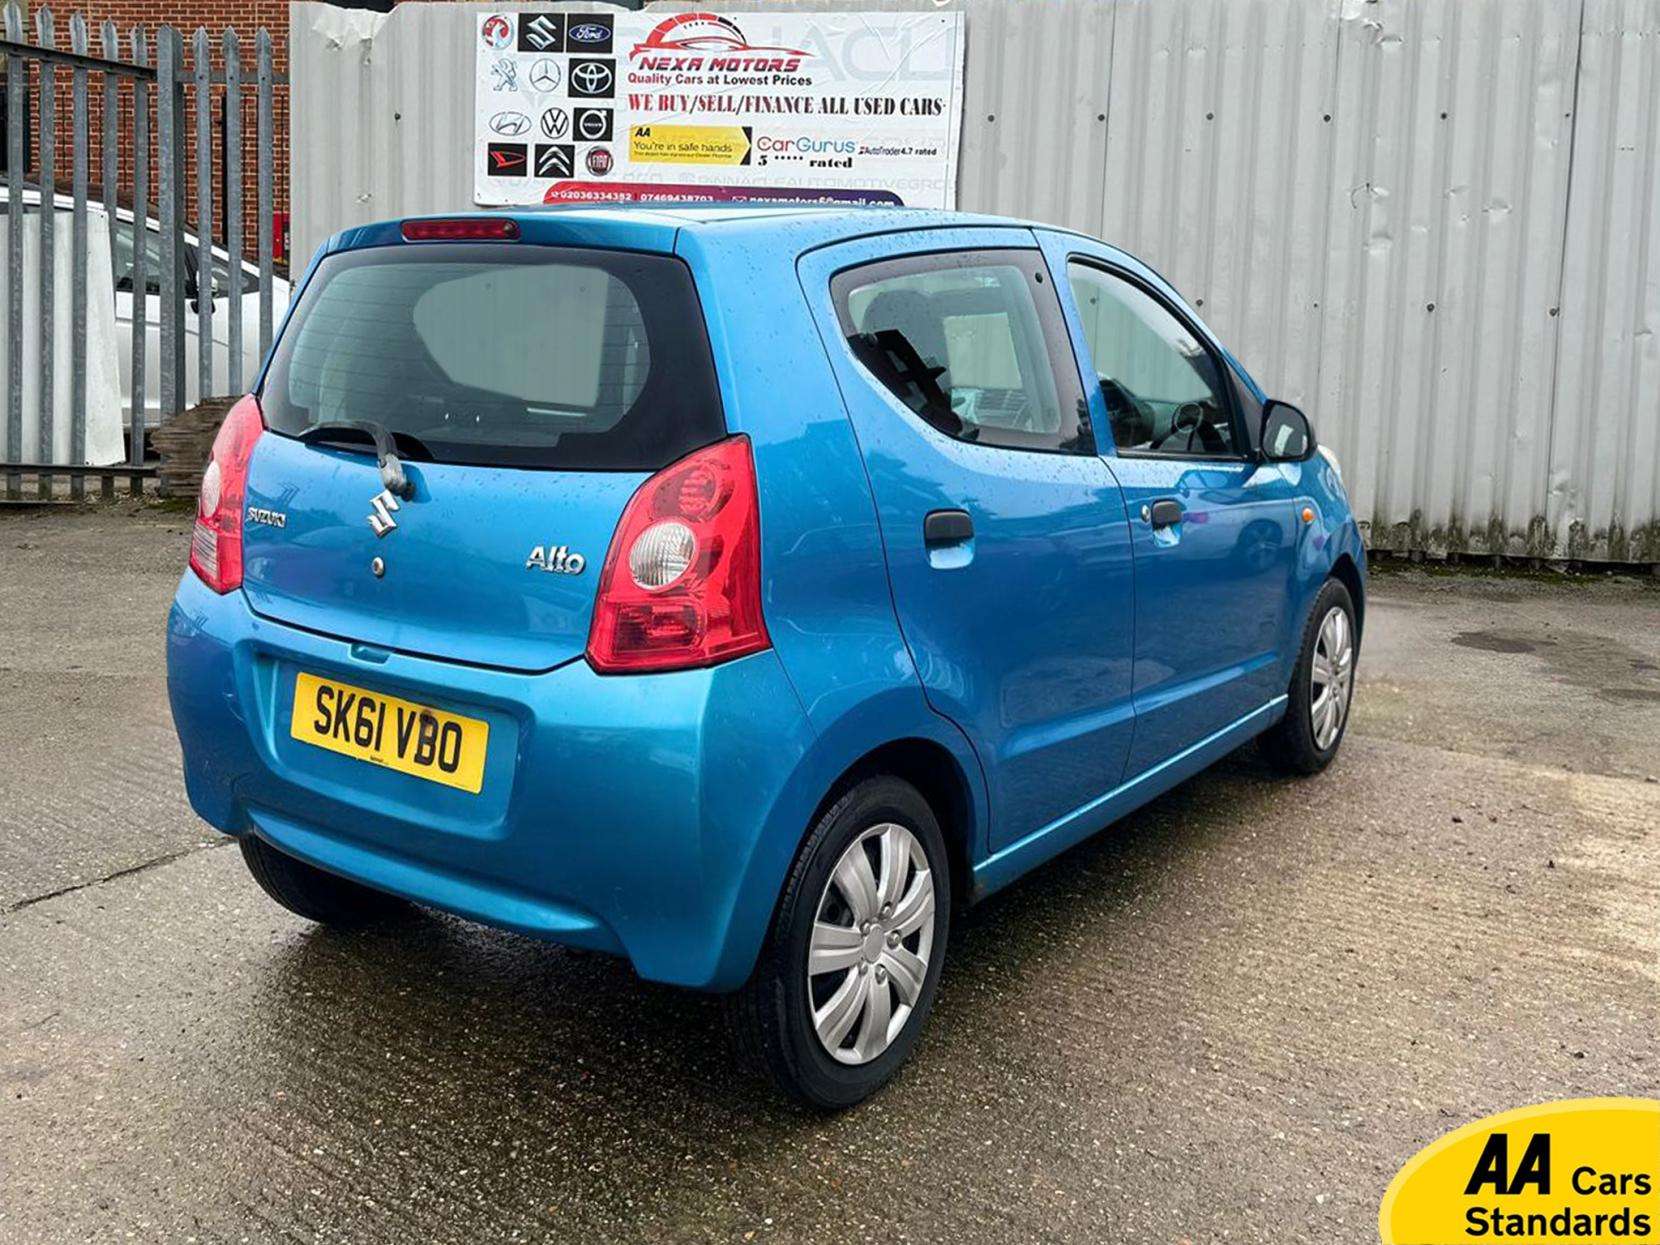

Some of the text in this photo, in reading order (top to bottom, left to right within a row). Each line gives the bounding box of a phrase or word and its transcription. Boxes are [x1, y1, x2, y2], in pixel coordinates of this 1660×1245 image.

[639, 57, 801, 73] NEXA MOTORS
[628, 73, 812, 86] Quality Cars at Lowest Prices
[628, 93, 942, 116] WE BUY/SELL/FINANCE ALL USED CARS
[635, 127, 651, 137] AA
[634, 141, 733, 152] You're in safe hands
[757, 136, 856, 153] CarGurus
[901, 147, 913, 156] 4.7
[915, 147, 937, 156] rated
[758, 155, 853, 168] 5 rated
[749, 195, 895, 206] nexamotors6@gmailcom
[247, 506, 286, 528] SUZUKI
[526, 545, 587, 576] Alto
[313, 684, 463, 774] SK61 VBO
